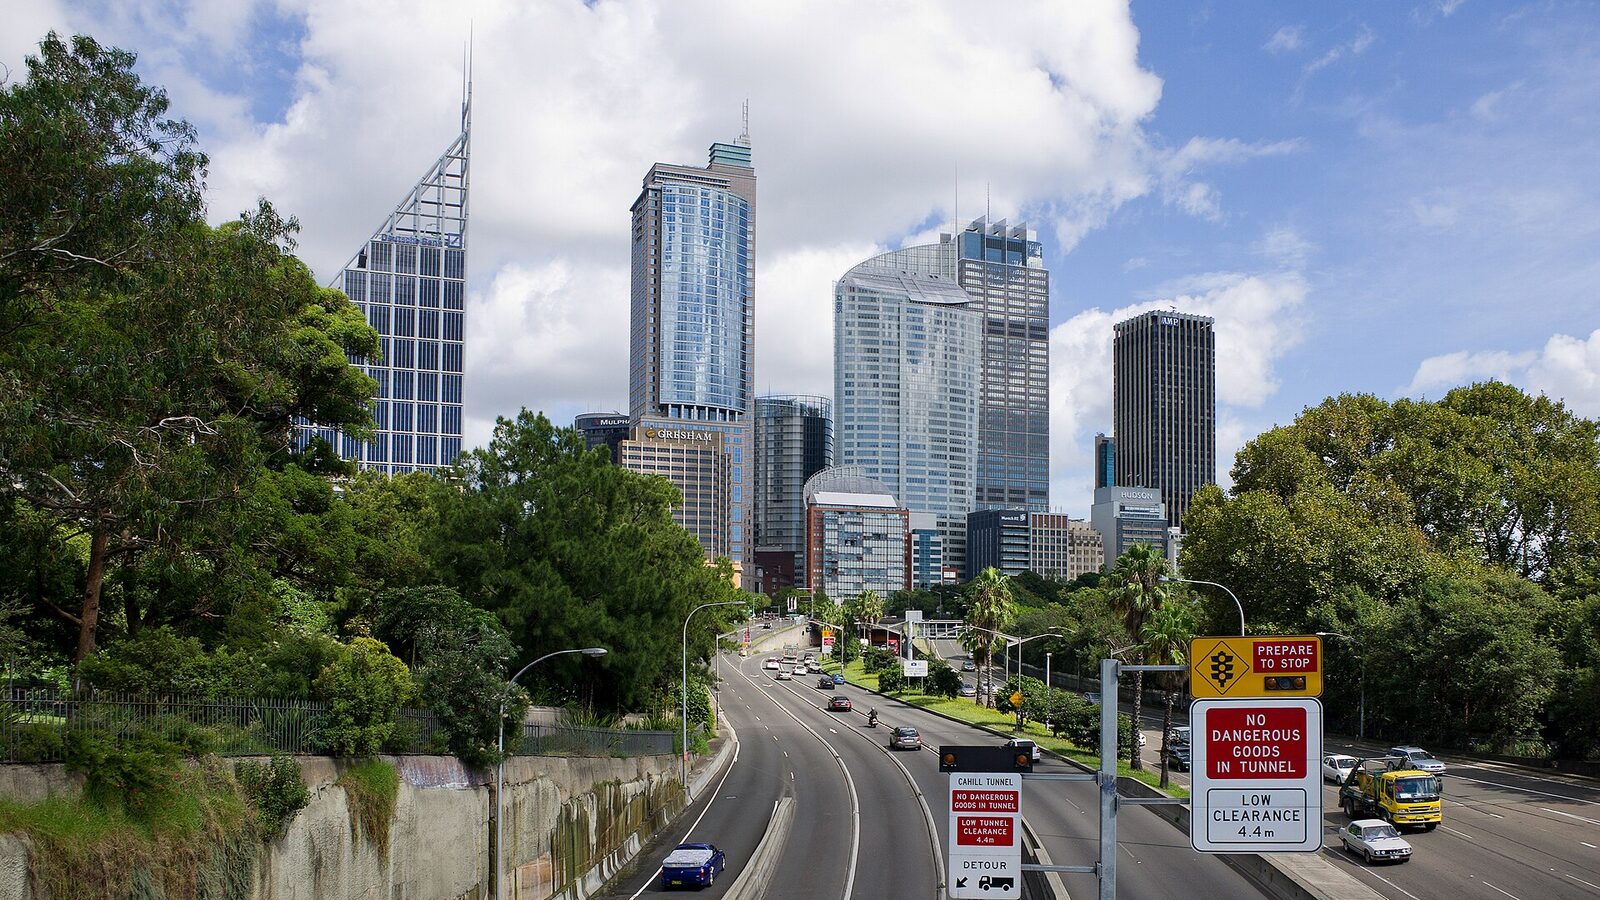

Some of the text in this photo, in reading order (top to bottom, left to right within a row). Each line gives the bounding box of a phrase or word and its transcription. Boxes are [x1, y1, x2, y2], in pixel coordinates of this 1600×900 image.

[1161, 317, 1179, 326] AMP
[657, 429, 712, 441] GRESHAM
[1121, 491, 1153, 499] HUDSON
[1257, 645, 1313, 655] PREPARE
[1260, 658, 1310, 668] TO STOP
[1246, 714, 1266, 726] NO
[1212, 729, 1301, 741] DANGEROUS
[1232, 745, 1280, 758] GOODS
[1217, 761, 1296, 773] IN TUNNEL
[958, 777, 1013, 786] CAHILL TUNNEL
[970, 793, 1014, 801] DANGEROUS
[1241, 794, 1271, 806] LOW
[989, 802, 1016, 810] TUNNEL
[1213, 810, 1300, 822] CLEARANCE
[980, 819, 1009, 827] TUNNEL
[1238, 826, 1274, 838] 4.4m
[963, 861, 1007, 870] DETOUR
